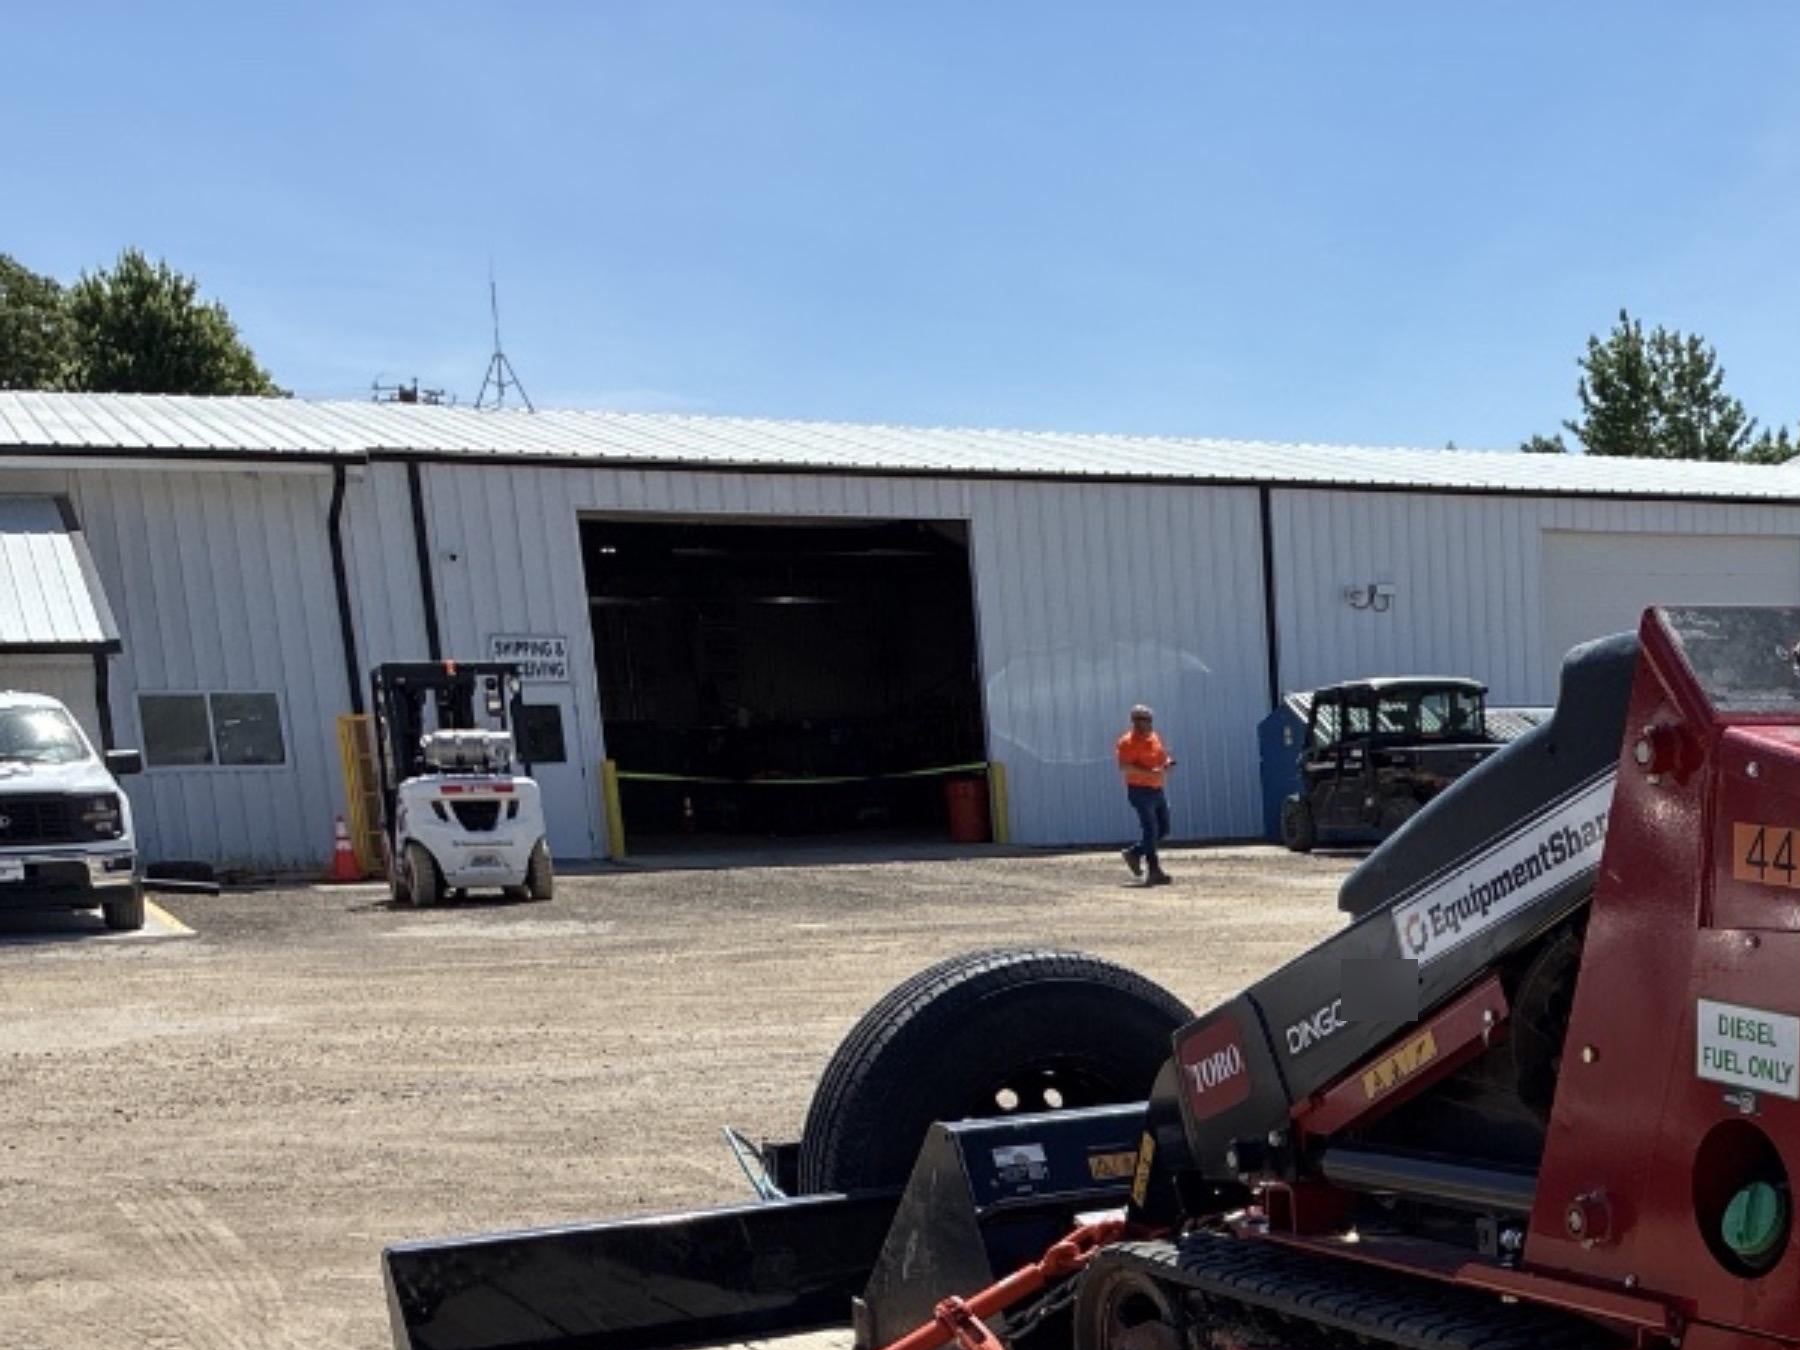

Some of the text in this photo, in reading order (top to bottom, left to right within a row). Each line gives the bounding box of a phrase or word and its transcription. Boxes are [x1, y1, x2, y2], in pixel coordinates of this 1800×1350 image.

[1428, 812, 1607, 937] EquipmentShar
[1718, 1013, 1777, 1048] DIESEL
[1184, 1043, 1244, 1094] TORO
[1702, 1045, 1795, 1085] FUEL ONLY
